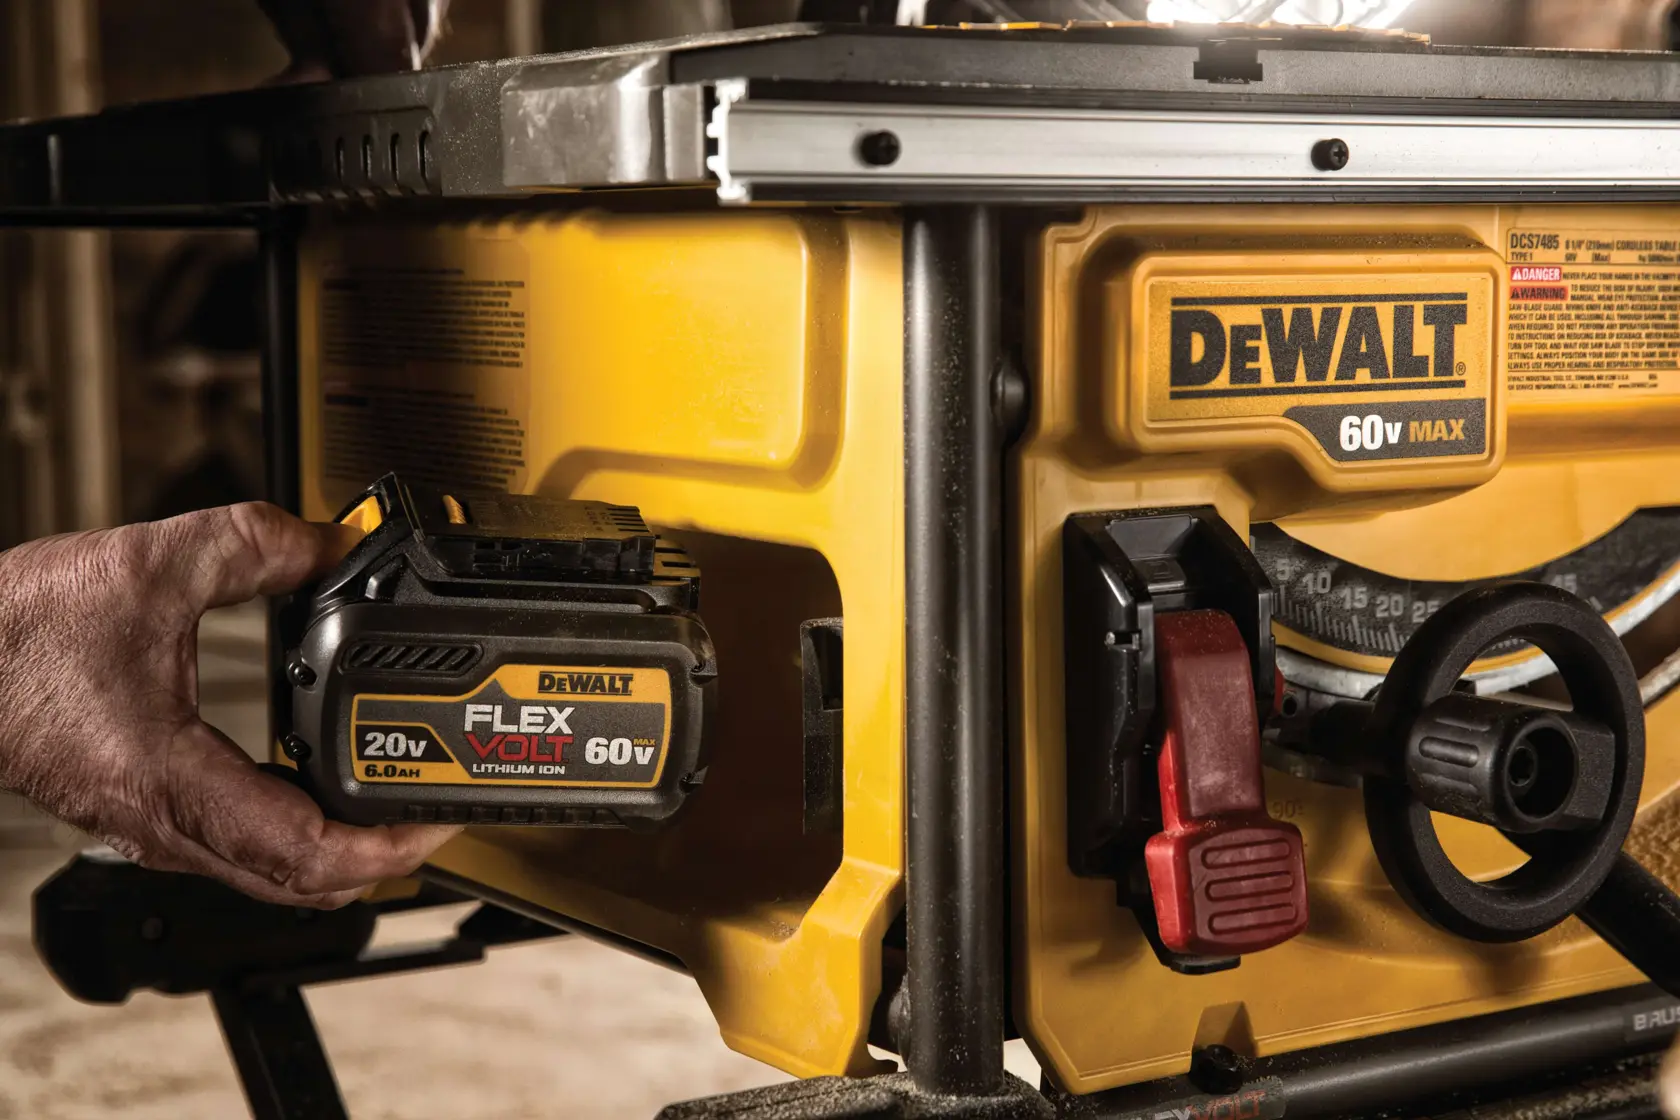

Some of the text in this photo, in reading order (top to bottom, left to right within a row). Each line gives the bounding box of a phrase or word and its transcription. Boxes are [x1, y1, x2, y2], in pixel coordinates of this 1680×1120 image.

[1510, 233, 1560, 250] DCS7485
[1510, 252, 1528, 261] TYPE
[1522, 268, 1560, 281] DANGER
[1520, 287, 1566, 300] WARNING
[1408, 418, 1465, 443] MAX
[1302, 571, 1332, 594] 10
[1340, 586, 1368, 609] 15
[1375, 593, 1404, 618] 20
[464, 703, 576, 735] FLEX
[465, 732, 575, 763] VOLT
[632, 737, 656, 746] MAX
[472, 763, 566, 776] LITHIUM ION
